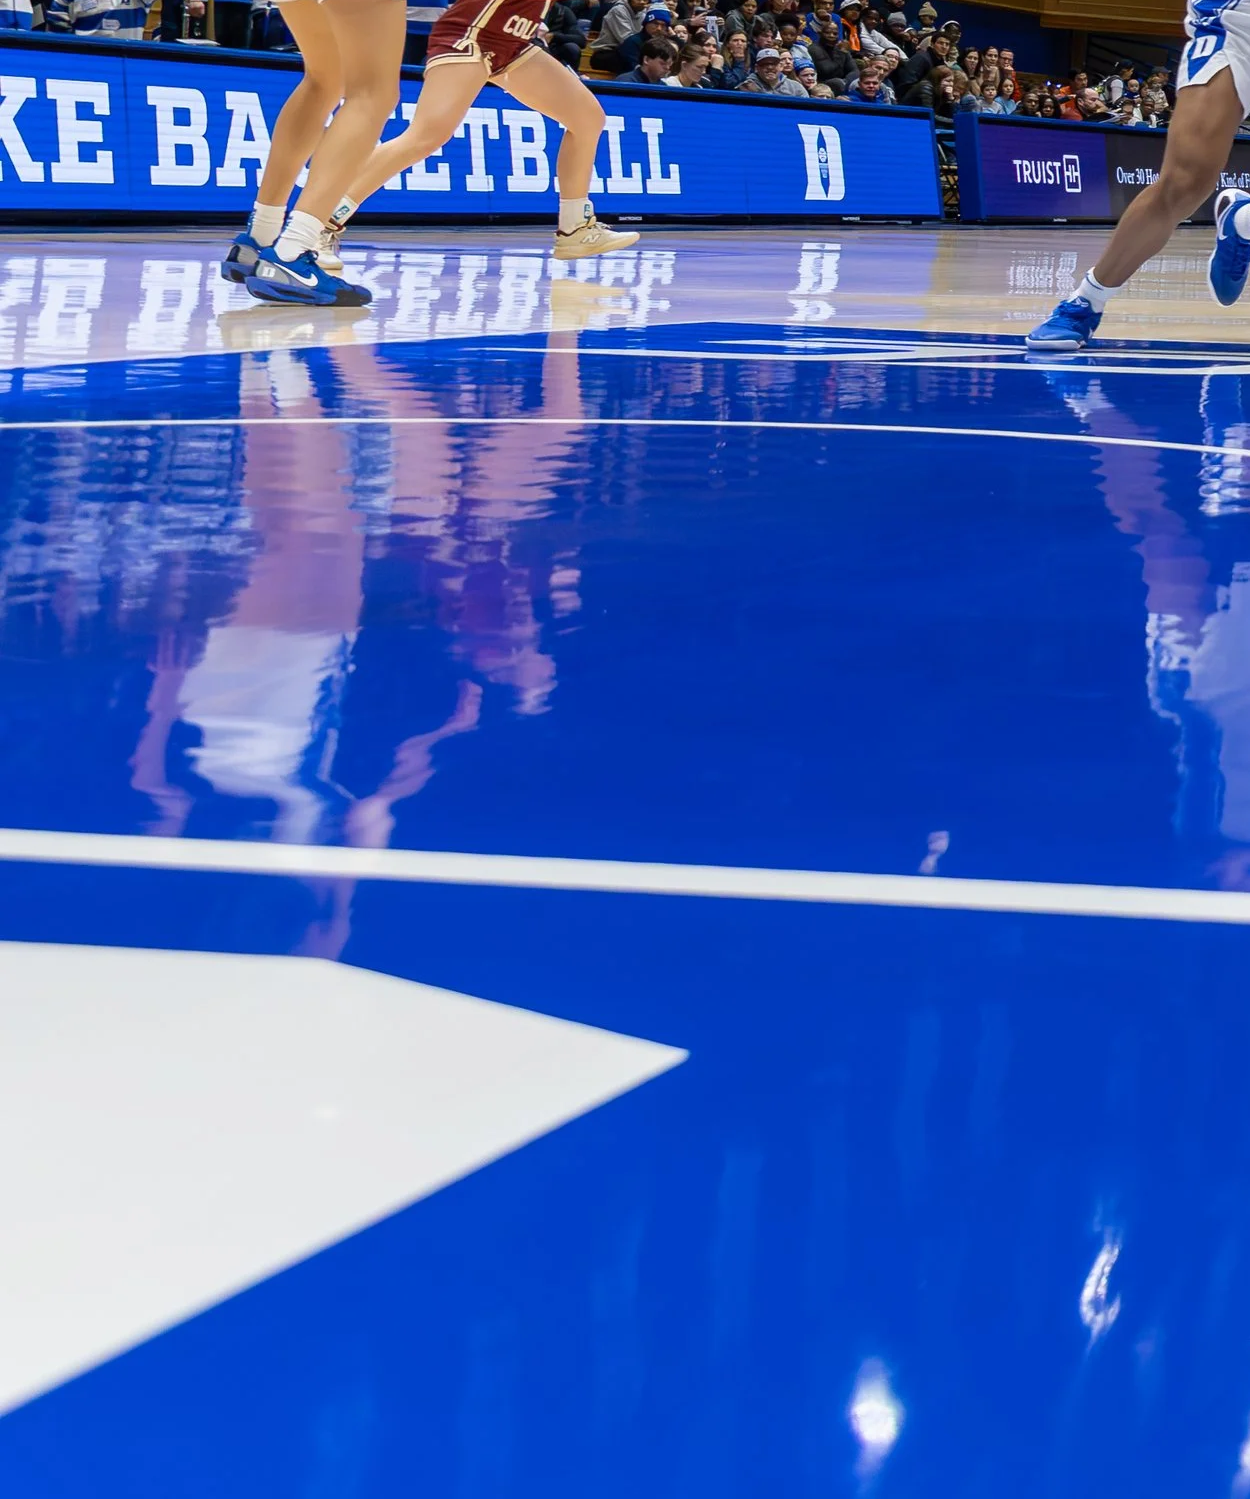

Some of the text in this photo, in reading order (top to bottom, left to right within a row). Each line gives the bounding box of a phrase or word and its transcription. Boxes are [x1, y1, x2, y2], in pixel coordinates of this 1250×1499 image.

[503, 15, 539, 40] COLL
[1192, 36, 1217, 56] D
[147, 85, 681, 194] BAETBLL
[798, 124, 845, 201] D
[1012, 159, 1061, 184] TRUIST
[1117, 166, 1135, 184] Over
[1136, 168, 1146, 185] 30
[1220, 173, 1237, 188] Kind
[1238, 173, 1245, 188] of
